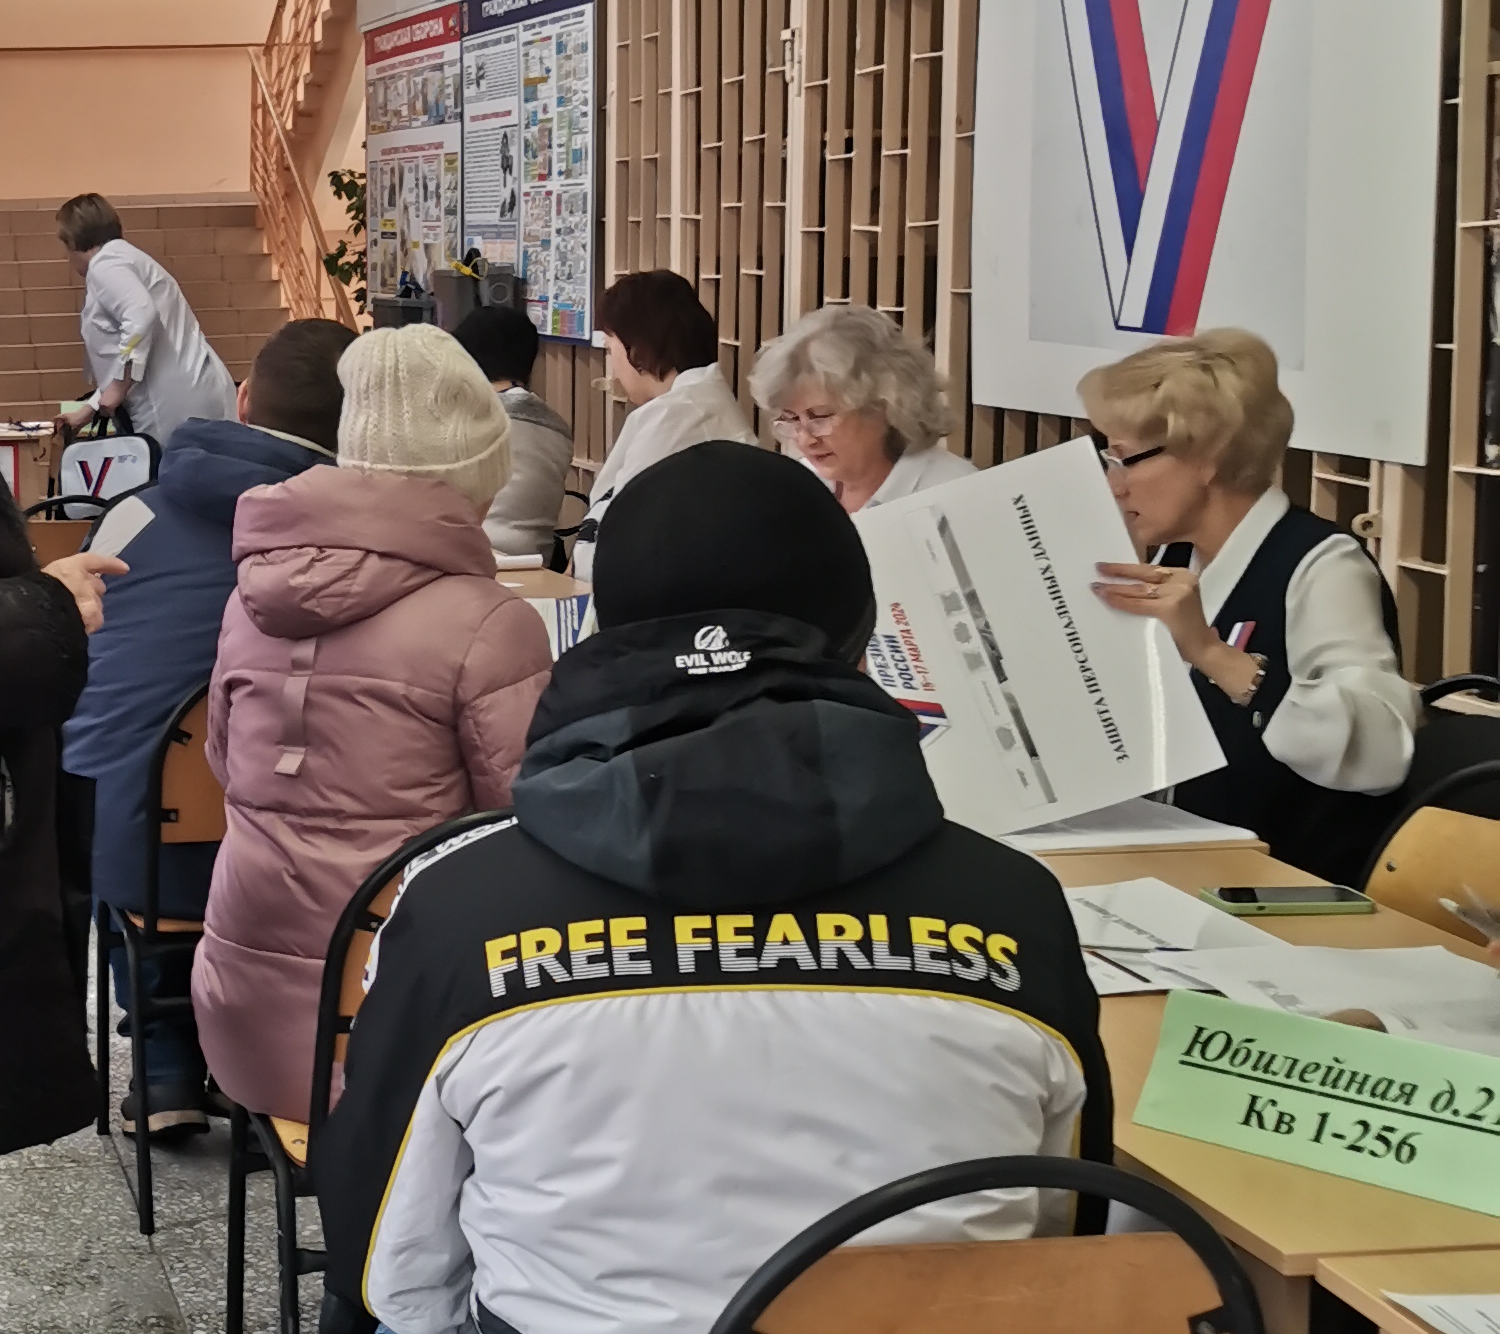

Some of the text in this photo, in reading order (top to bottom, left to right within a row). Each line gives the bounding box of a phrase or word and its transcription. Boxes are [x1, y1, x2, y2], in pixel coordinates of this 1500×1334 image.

[890, 601, 911, 627] 2024
[899, 629, 924, 663] МАРТА
[1011, 494, 1130, 765] ЗАЩИТА ПЕРСОНАЛЬНЫХ ДАННЫХ
[675, 650, 752, 669] EVIL WOLF
[881, 634, 920, 691] РОССИИ
[485, 916, 654, 999] FREE
[673, 912, 1022, 993] FEARLESS
[1180, 1024, 1419, 1108] Юбилейная
[1237, 1093, 1424, 1166] Кв 1-256
